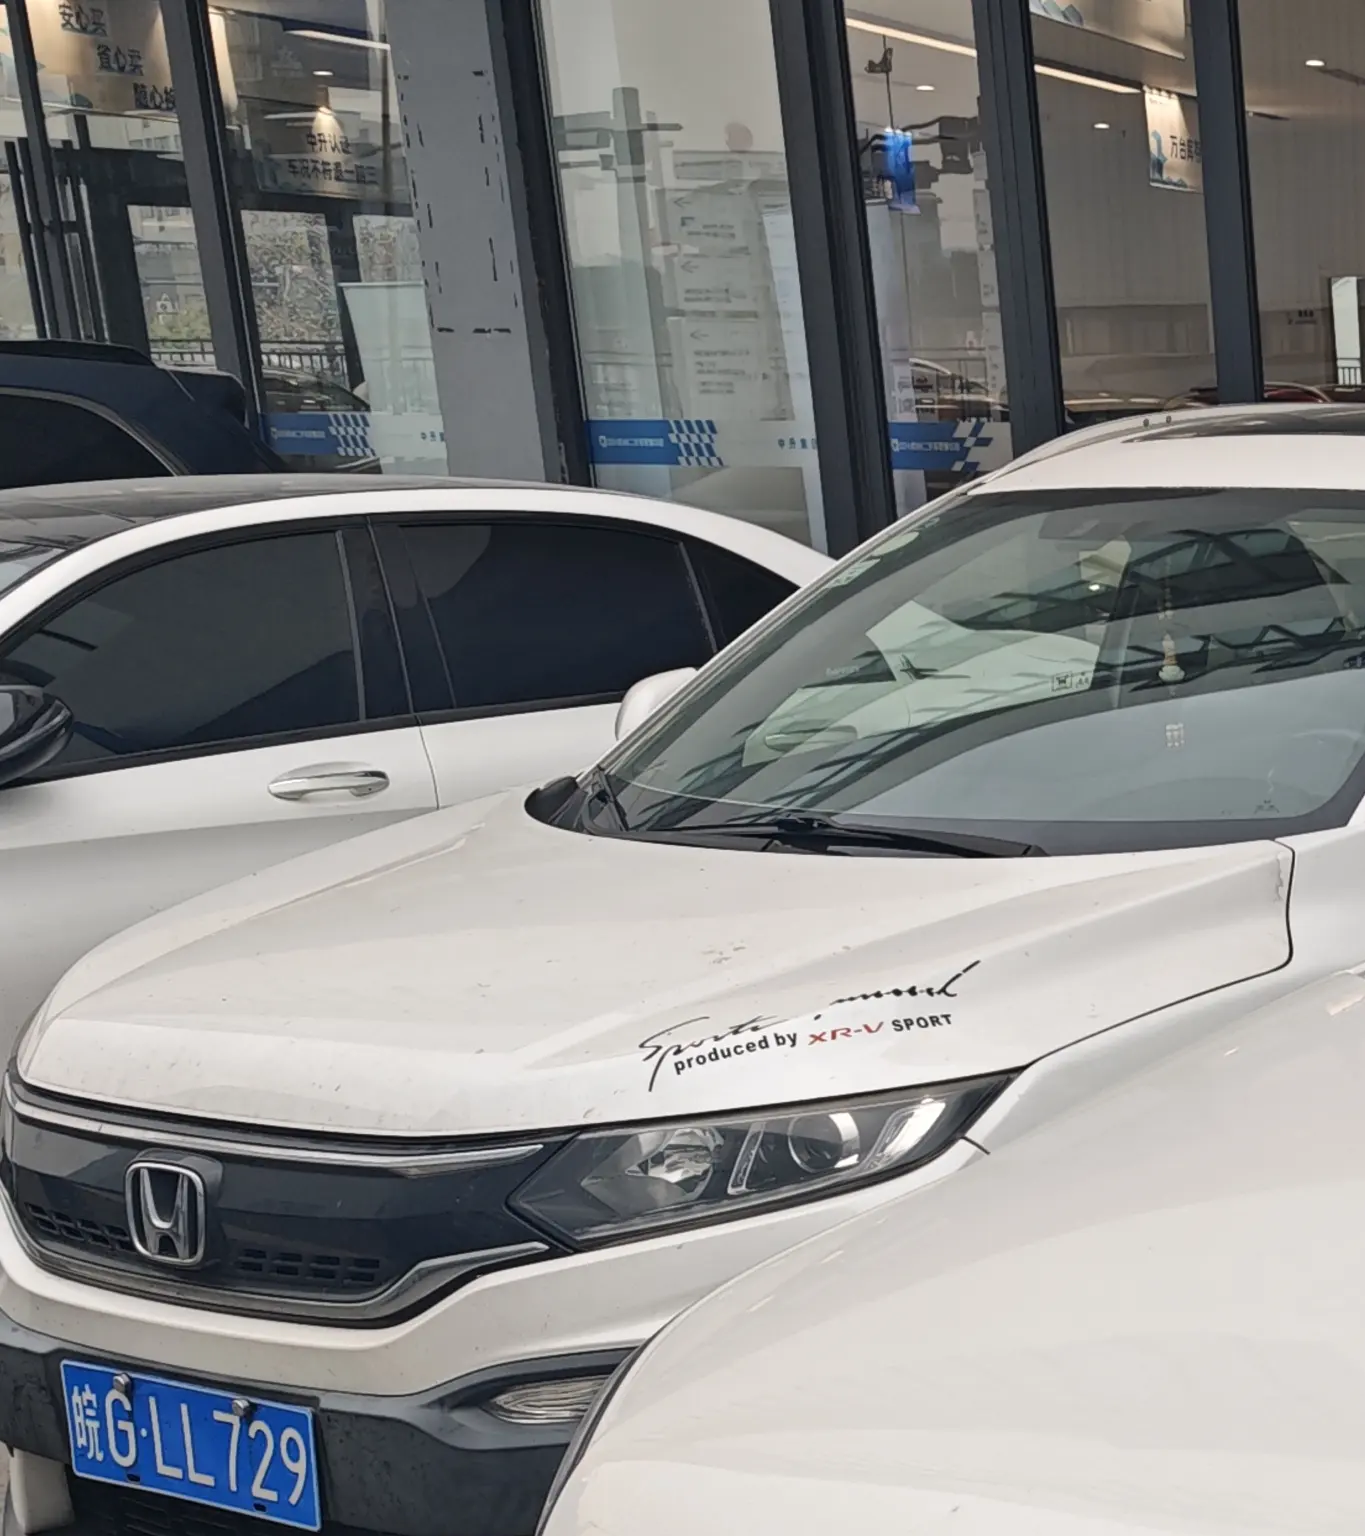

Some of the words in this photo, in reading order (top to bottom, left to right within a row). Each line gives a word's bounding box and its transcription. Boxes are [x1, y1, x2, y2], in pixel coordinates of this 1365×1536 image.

[673, 1037, 770, 1076] produced
[776, 1031, 799, 1048] by
[807, 1021, 885, 1047] XR-V
[891, 1013, 953, 1032] SPORT
